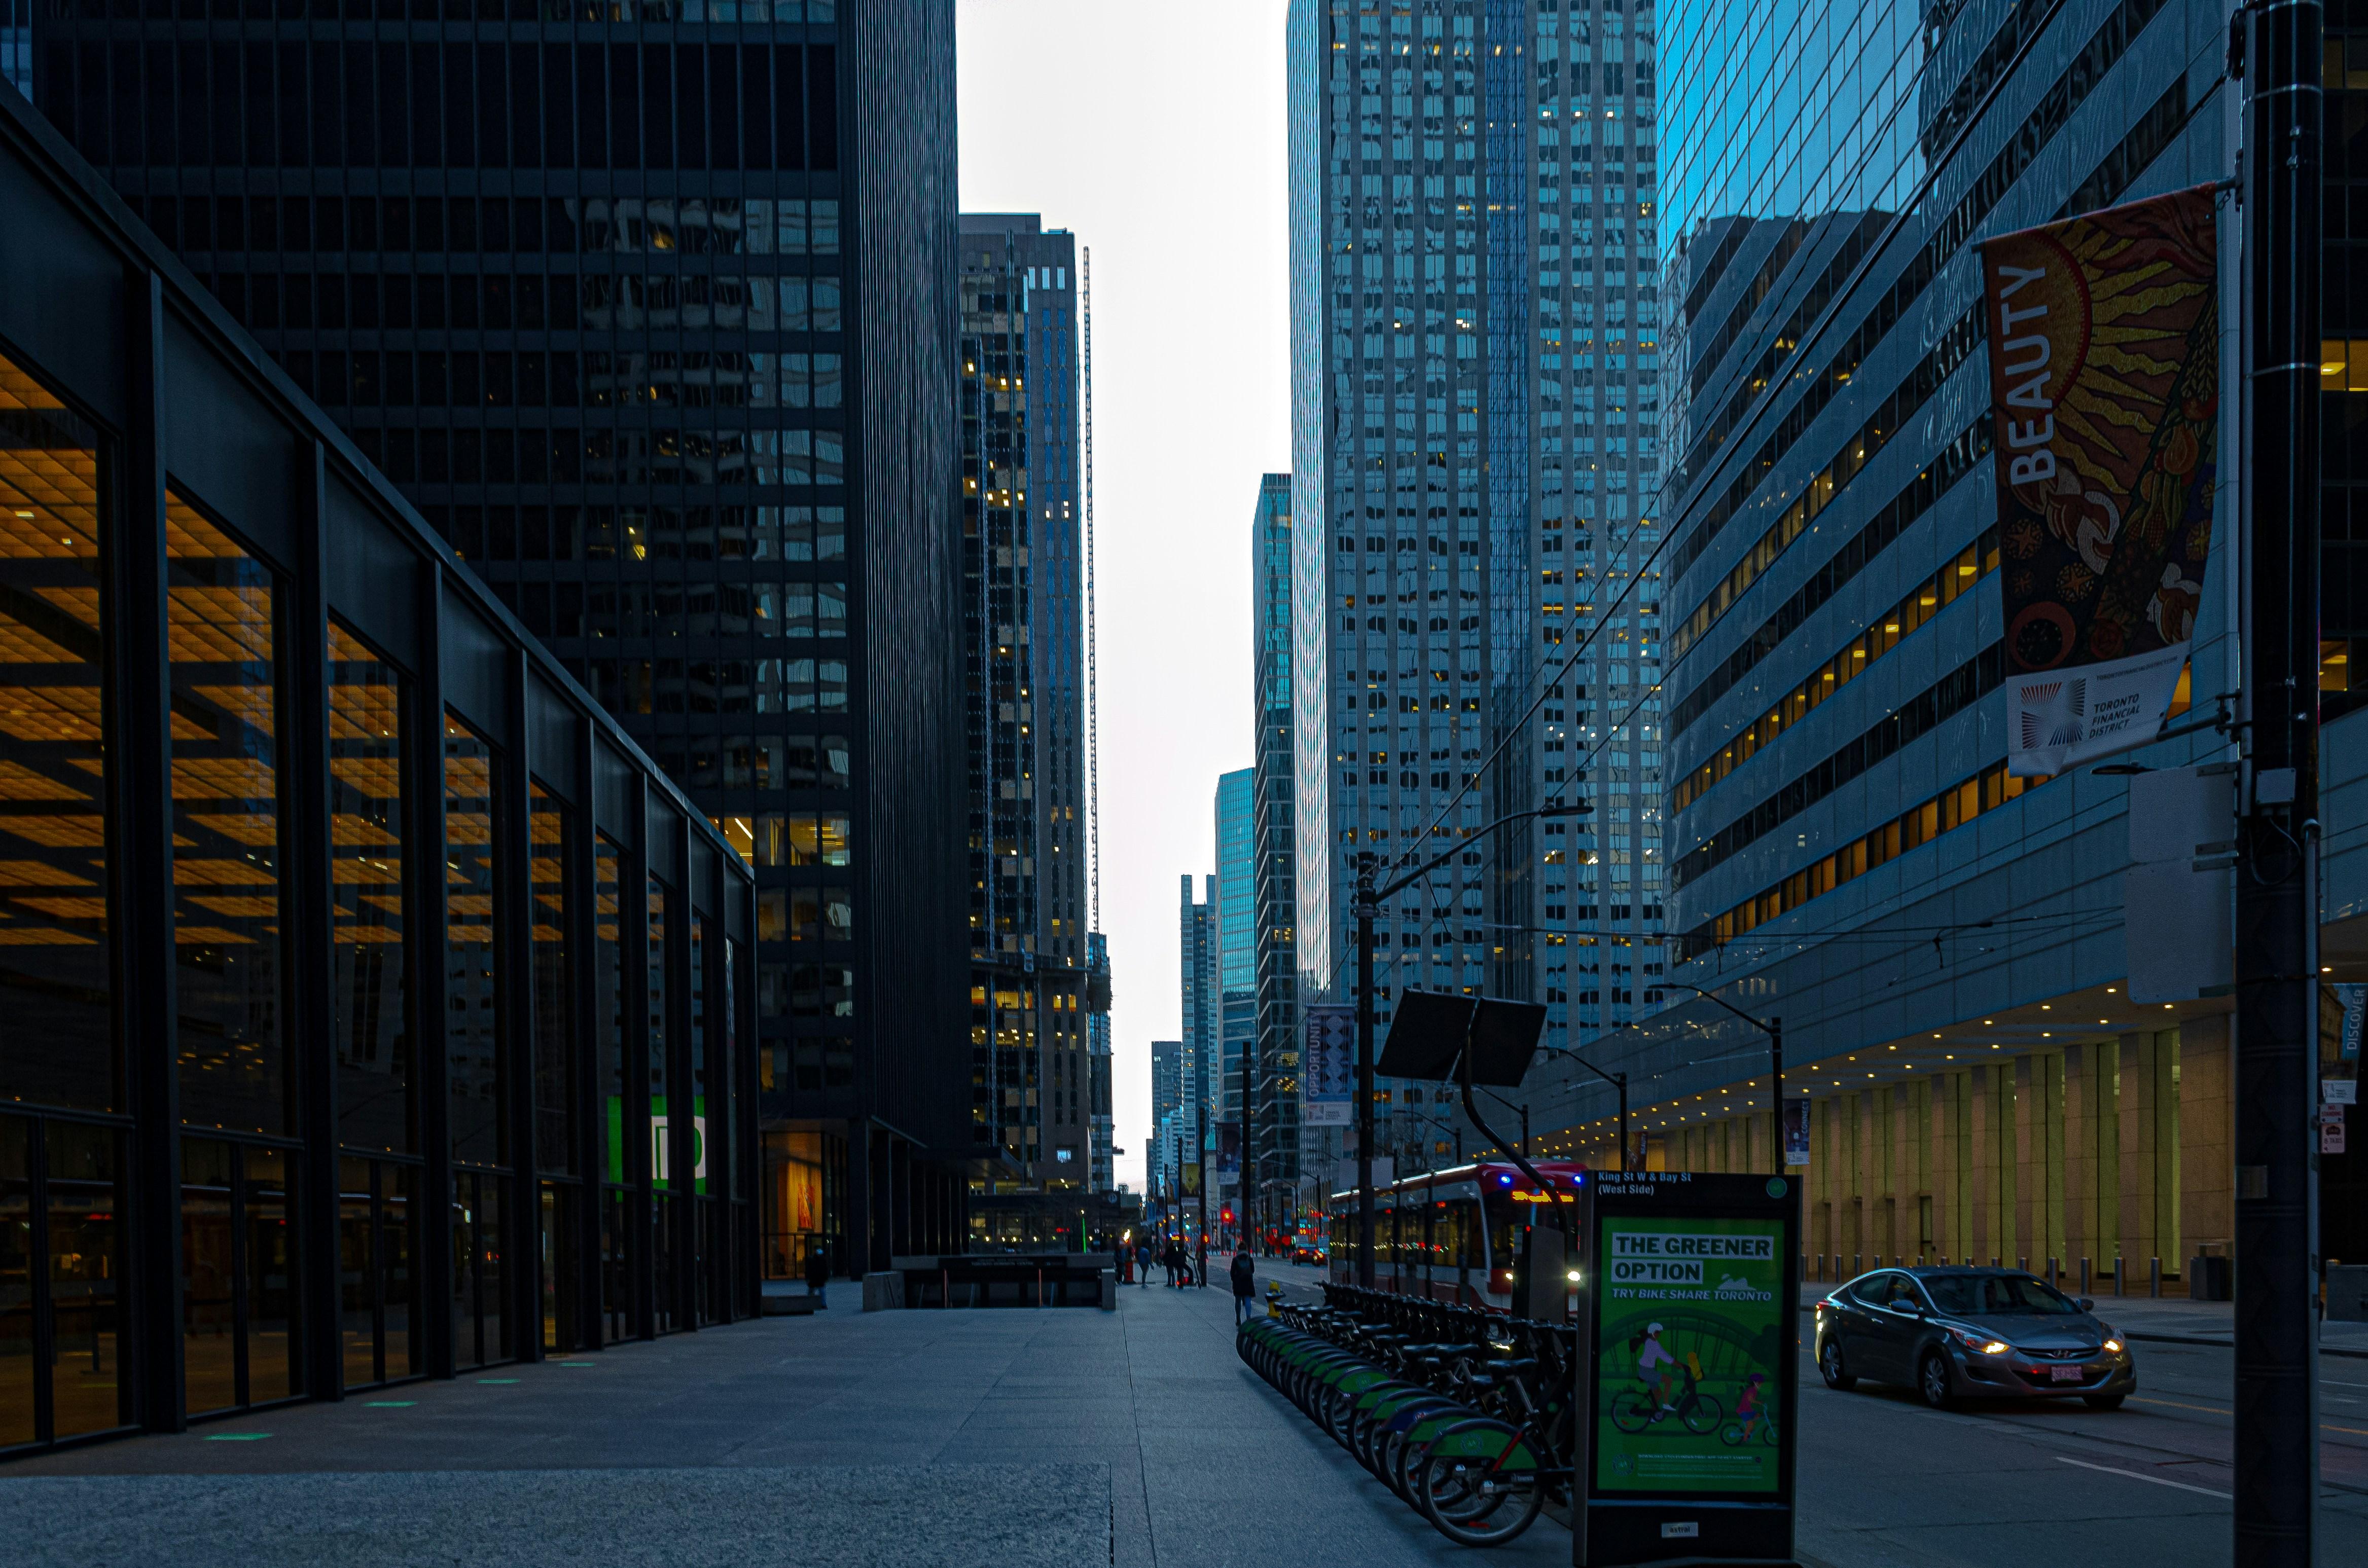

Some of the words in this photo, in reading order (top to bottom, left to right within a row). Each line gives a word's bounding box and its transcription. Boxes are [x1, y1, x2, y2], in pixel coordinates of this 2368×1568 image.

[1998, 265, 2056, 486] BEAUTY
[2094, 692, 2140, 714] TORONTO
[2092, 704, 2140, 726] FINANCIAL
[2089, 719, 2130, 740] DISTRICT
[2347, 989, 2365, 1051] DISCOVER
[1309, 1010, 1320, 1098] OPPORTUNITY
[1598, 1172, 1620, 1183] King
[1624, 1172, 1634, 1182] St
[1637, 1172, 1646, 1182] W
[1649, 1172, 1657, 1182] &
[1659, 1172, 1678, 1184] Bay
[1680, 1173, 1692, 1182] St
[1598, 1184, 1626, 1196] (West
[1629, 1184, 1654, 1196] Side)
[1616, 1236, 1660, 1254] THE
[1665, 1237, 1770, 1256] GREENER
[1614, 1262, 1701, 1281] OPTION
[1612, 1288, 1635, 1298] TRY
[1638, 1289, 1667, 1299] BIKE
[1669, 1290, 1710, 1300] SHARE
[1713, 1290, 1772, 1301] TORONTO
